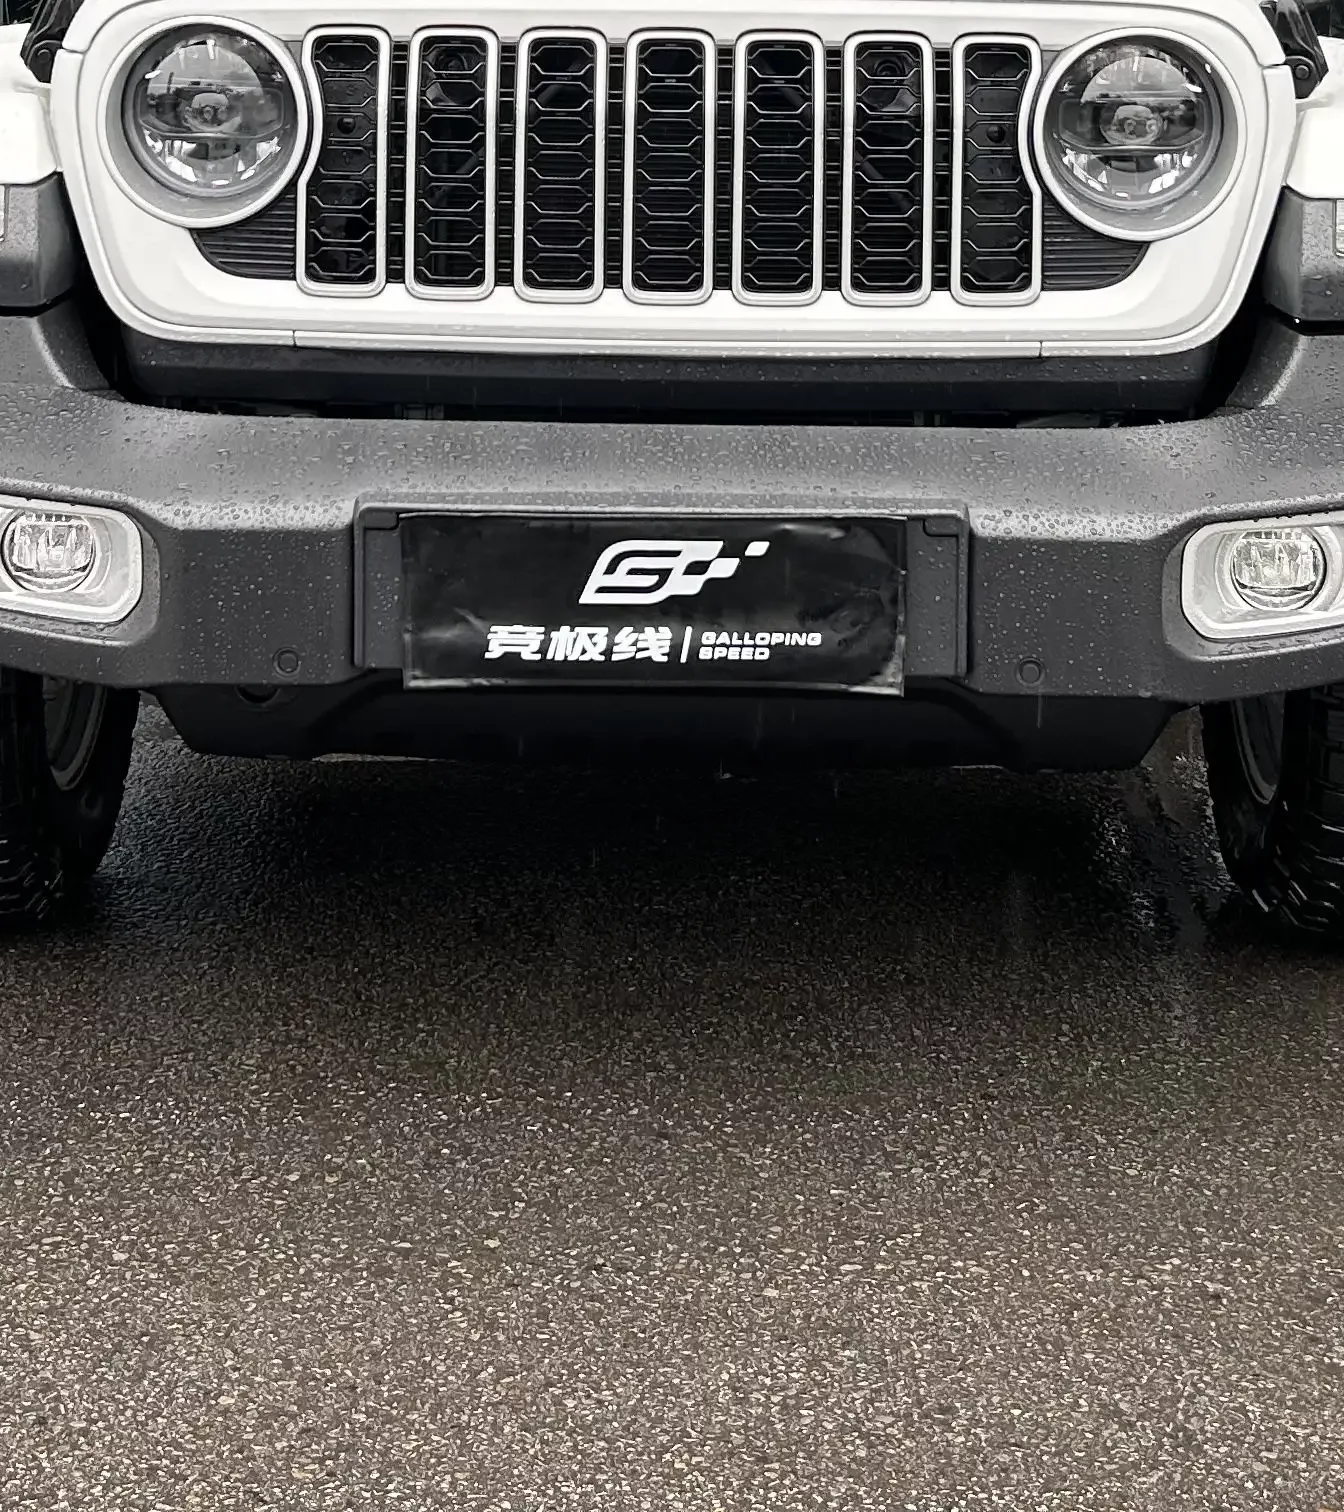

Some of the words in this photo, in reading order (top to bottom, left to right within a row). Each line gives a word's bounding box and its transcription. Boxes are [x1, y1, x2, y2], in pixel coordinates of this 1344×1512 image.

[484, 624, 673, 663] 竞极线
[701, 631, 822, 646] GALLOPING
[698, 647, 770, 661] SPEED
